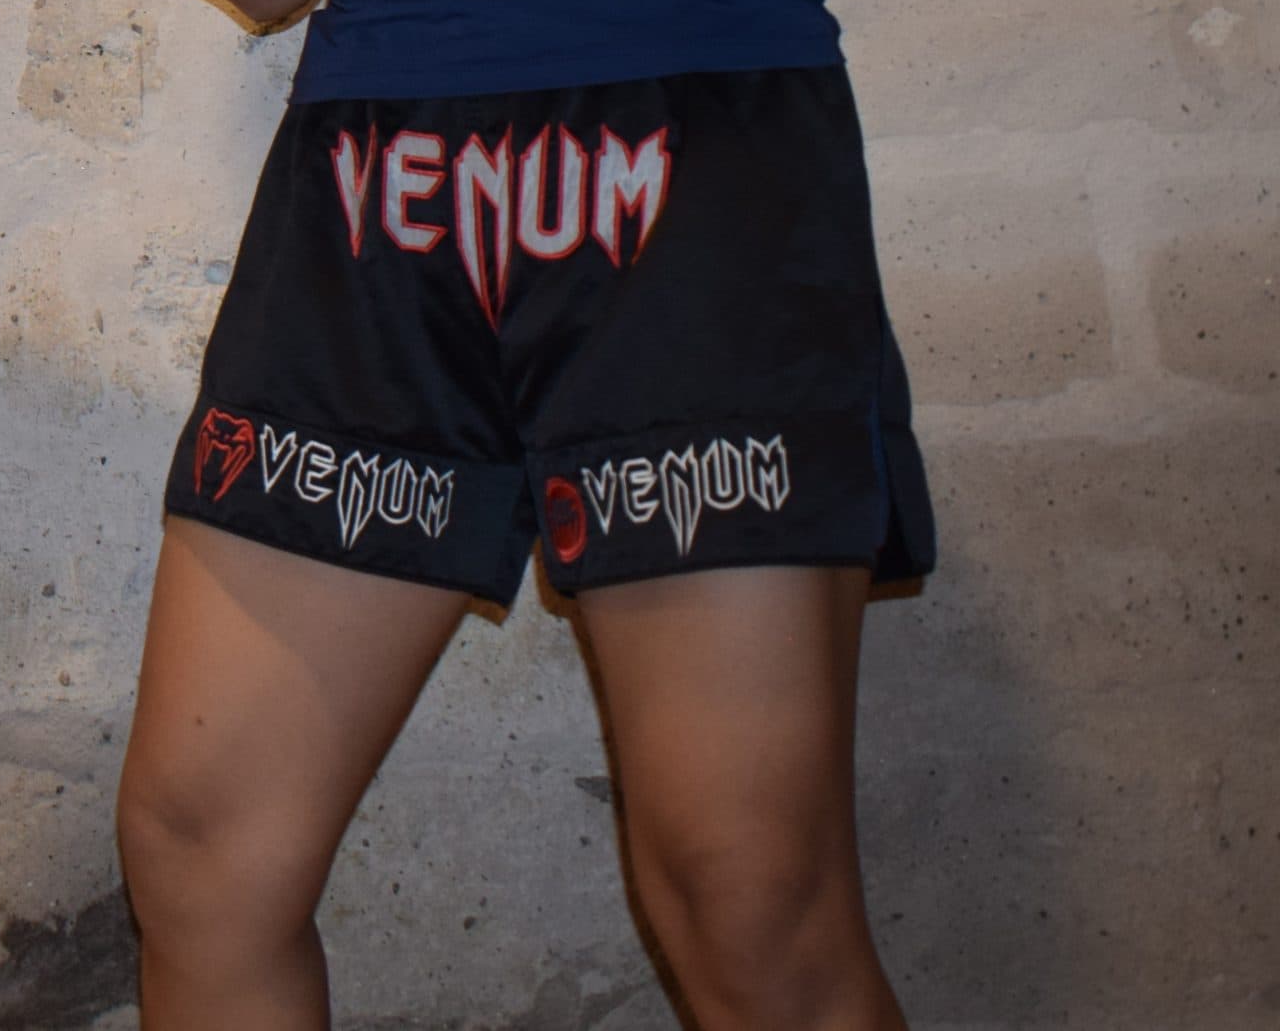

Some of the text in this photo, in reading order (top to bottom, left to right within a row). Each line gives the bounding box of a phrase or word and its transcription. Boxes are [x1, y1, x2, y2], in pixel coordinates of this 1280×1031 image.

[330, 121, 672, 337] VENUM
[260, 423, 455, 550] VENUM
[581, 434, 790, 556] VENUM
